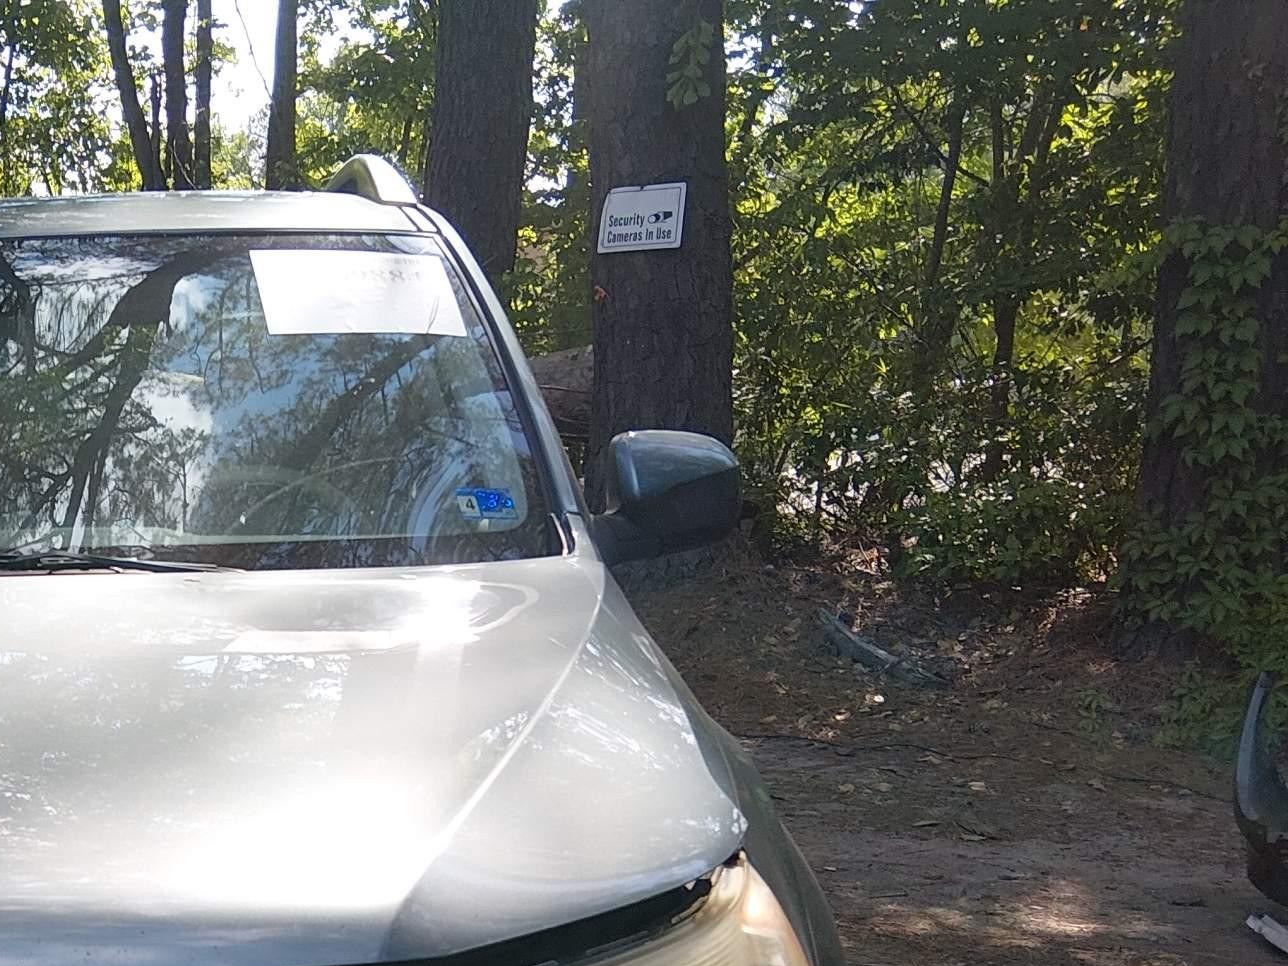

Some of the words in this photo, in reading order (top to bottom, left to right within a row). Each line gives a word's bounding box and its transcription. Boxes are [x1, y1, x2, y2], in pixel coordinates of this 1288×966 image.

[608, 213, 645, 228] Security
[607, 230, 643, 243] Cameras
[656, 227, 672, 240] Use
